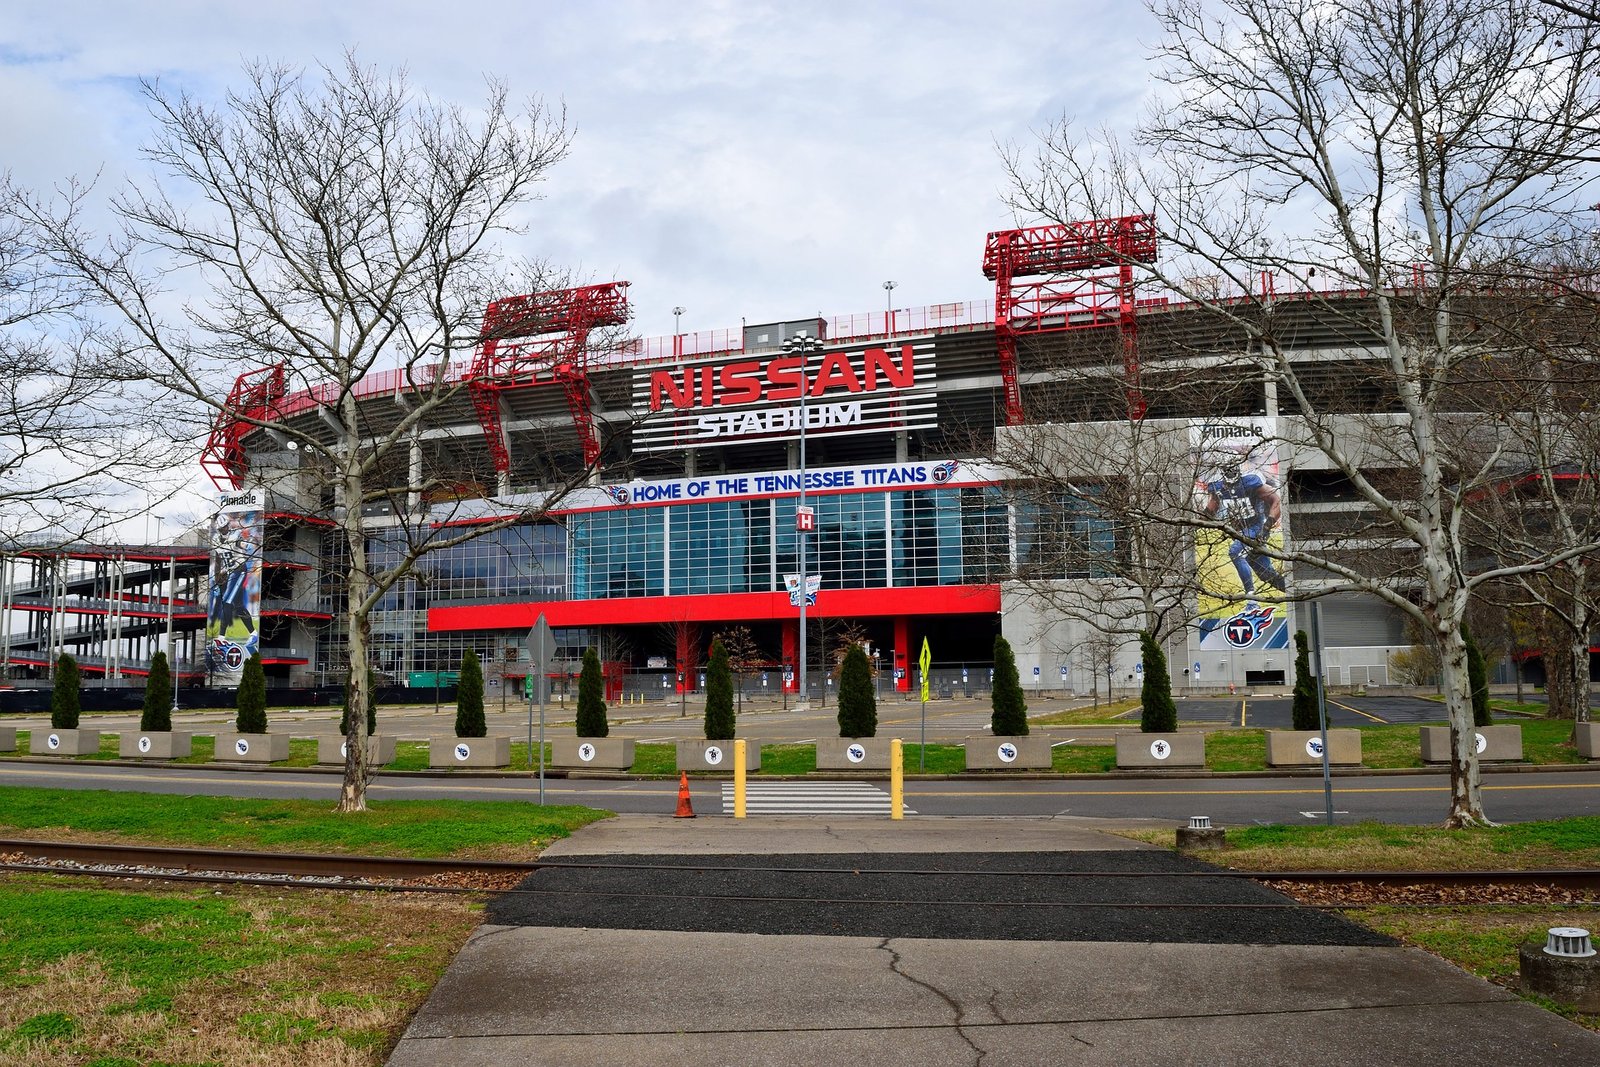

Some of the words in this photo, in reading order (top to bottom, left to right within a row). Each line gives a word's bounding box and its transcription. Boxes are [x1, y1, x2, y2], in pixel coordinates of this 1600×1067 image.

[650, 344, 915, 412] NISSAN
[697, 402, 862, 438] STADIUM
[1202, 422, 1263, 438] Pinnacle
[633, 481, 681, 501] HOME
[687, 480, 711, 497] OF
[716, 478, 748, 494] THE
[754, 471, 855, 493] TENNESSEE
[863, 466, 927, 485] TITANS
[220, 493, 257, 507] Pinnacle
[801, 514, 812, 530] H
